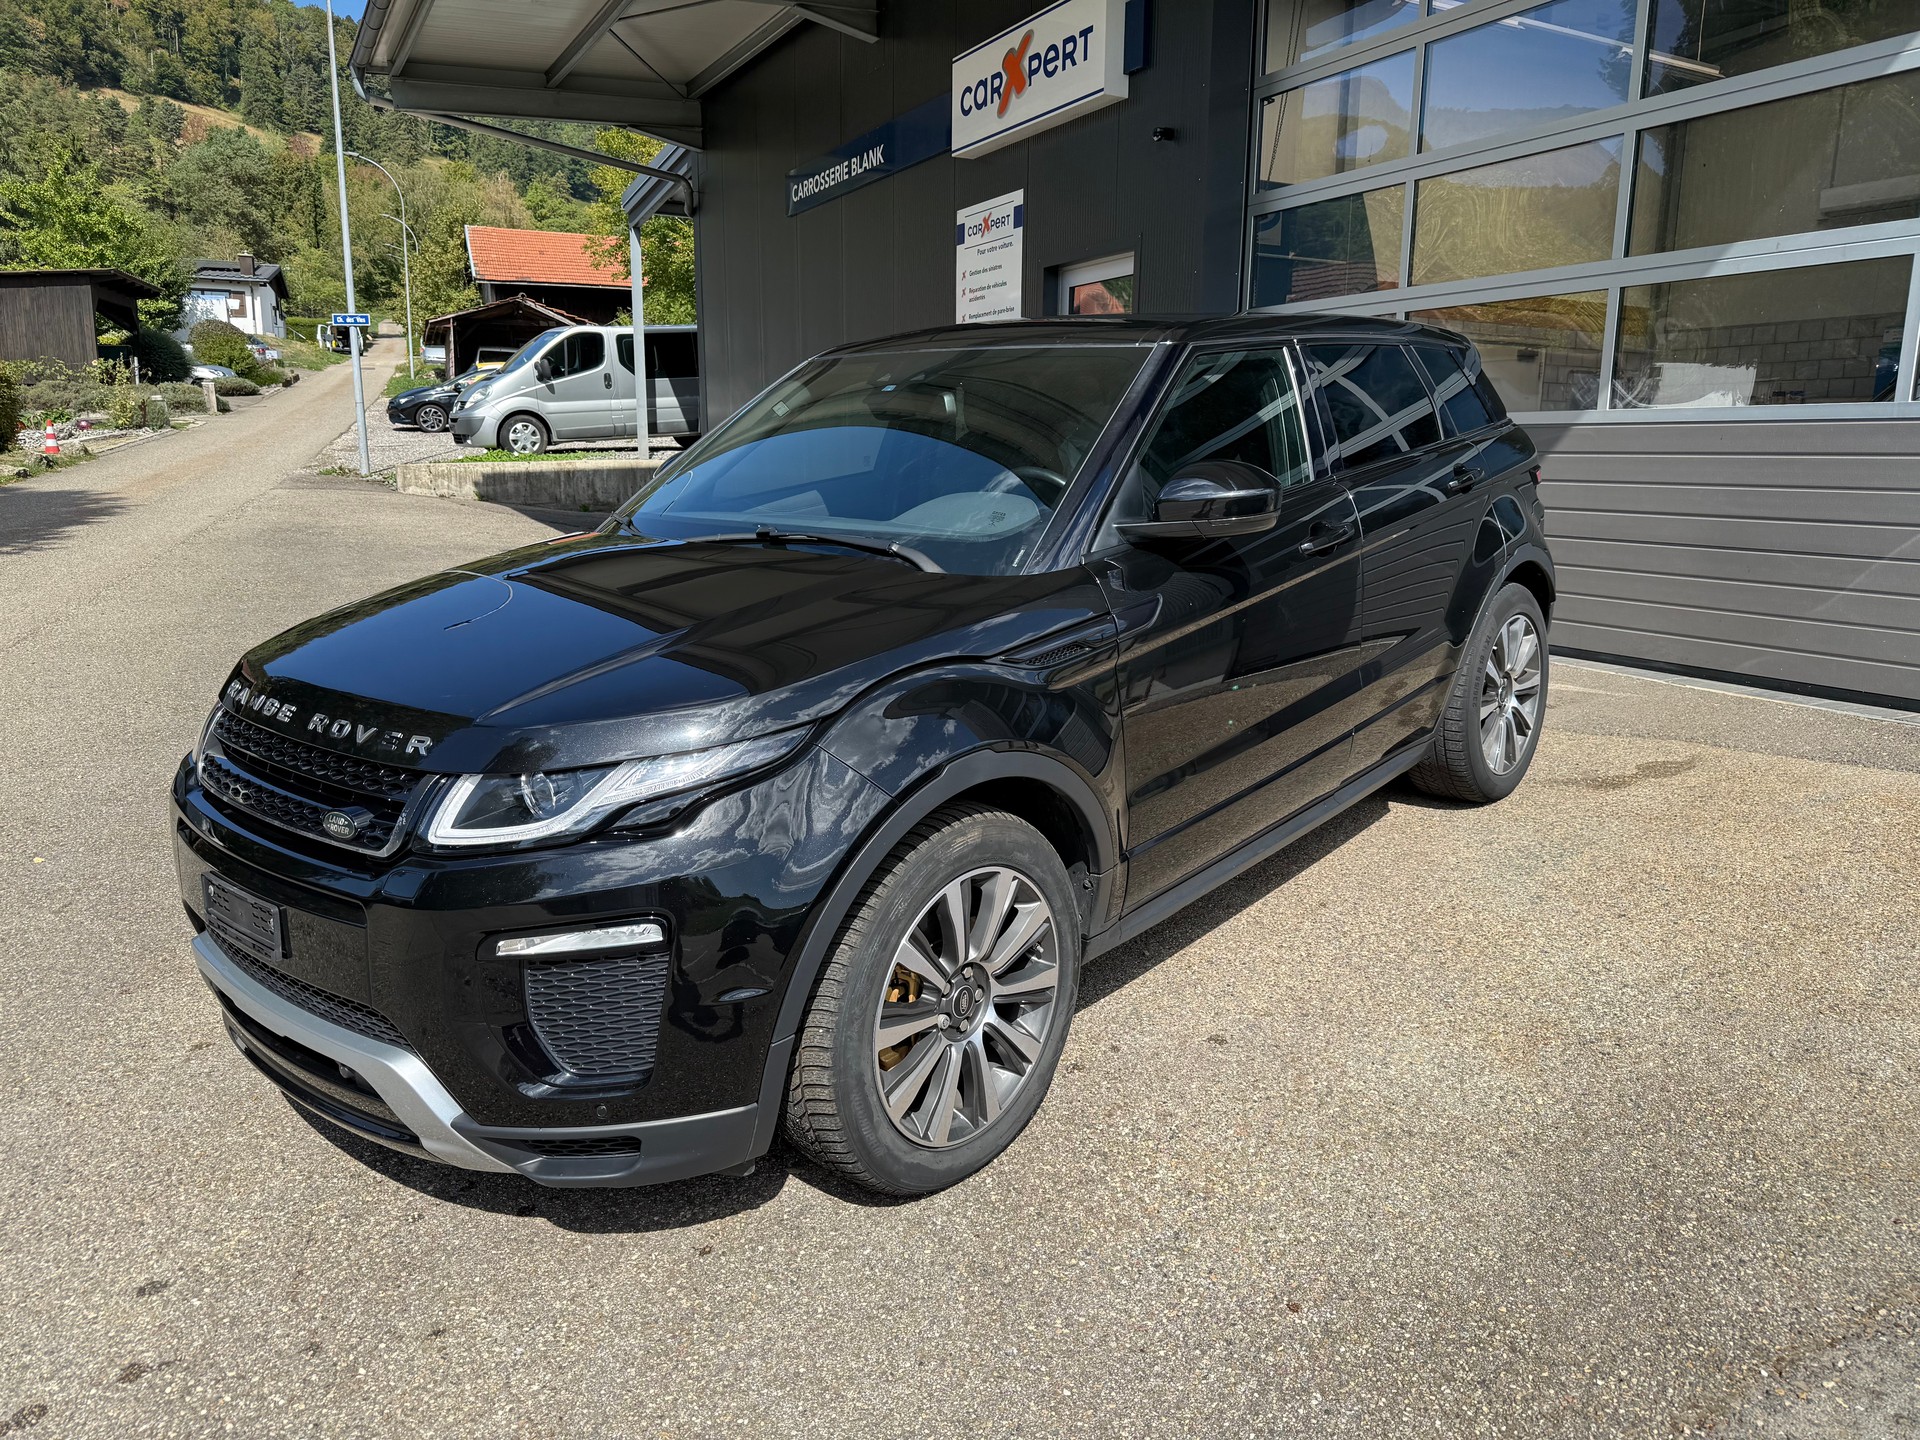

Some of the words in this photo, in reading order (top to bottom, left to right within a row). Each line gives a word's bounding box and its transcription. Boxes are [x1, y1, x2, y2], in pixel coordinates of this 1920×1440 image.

[792, 160, 849, 202] CARROSSERIE
[851, 144, 885, 177] BLANK
[976, 248, 987, 256] Pour
[987, 245, 998, 253] votre
[998, 241, 1014, 251] voiture.
[969, 269, 981, 277] Gestion
[989, 264, 1002, 272] sinistres
[969, 311, 992, 320] Remplacement
[226, 679, 297, 723] RANGE
[307, 712, 433, 756] ROVER
[329, 815, 345, 826] LAND
[330, 823, 350, 835] ROVER
